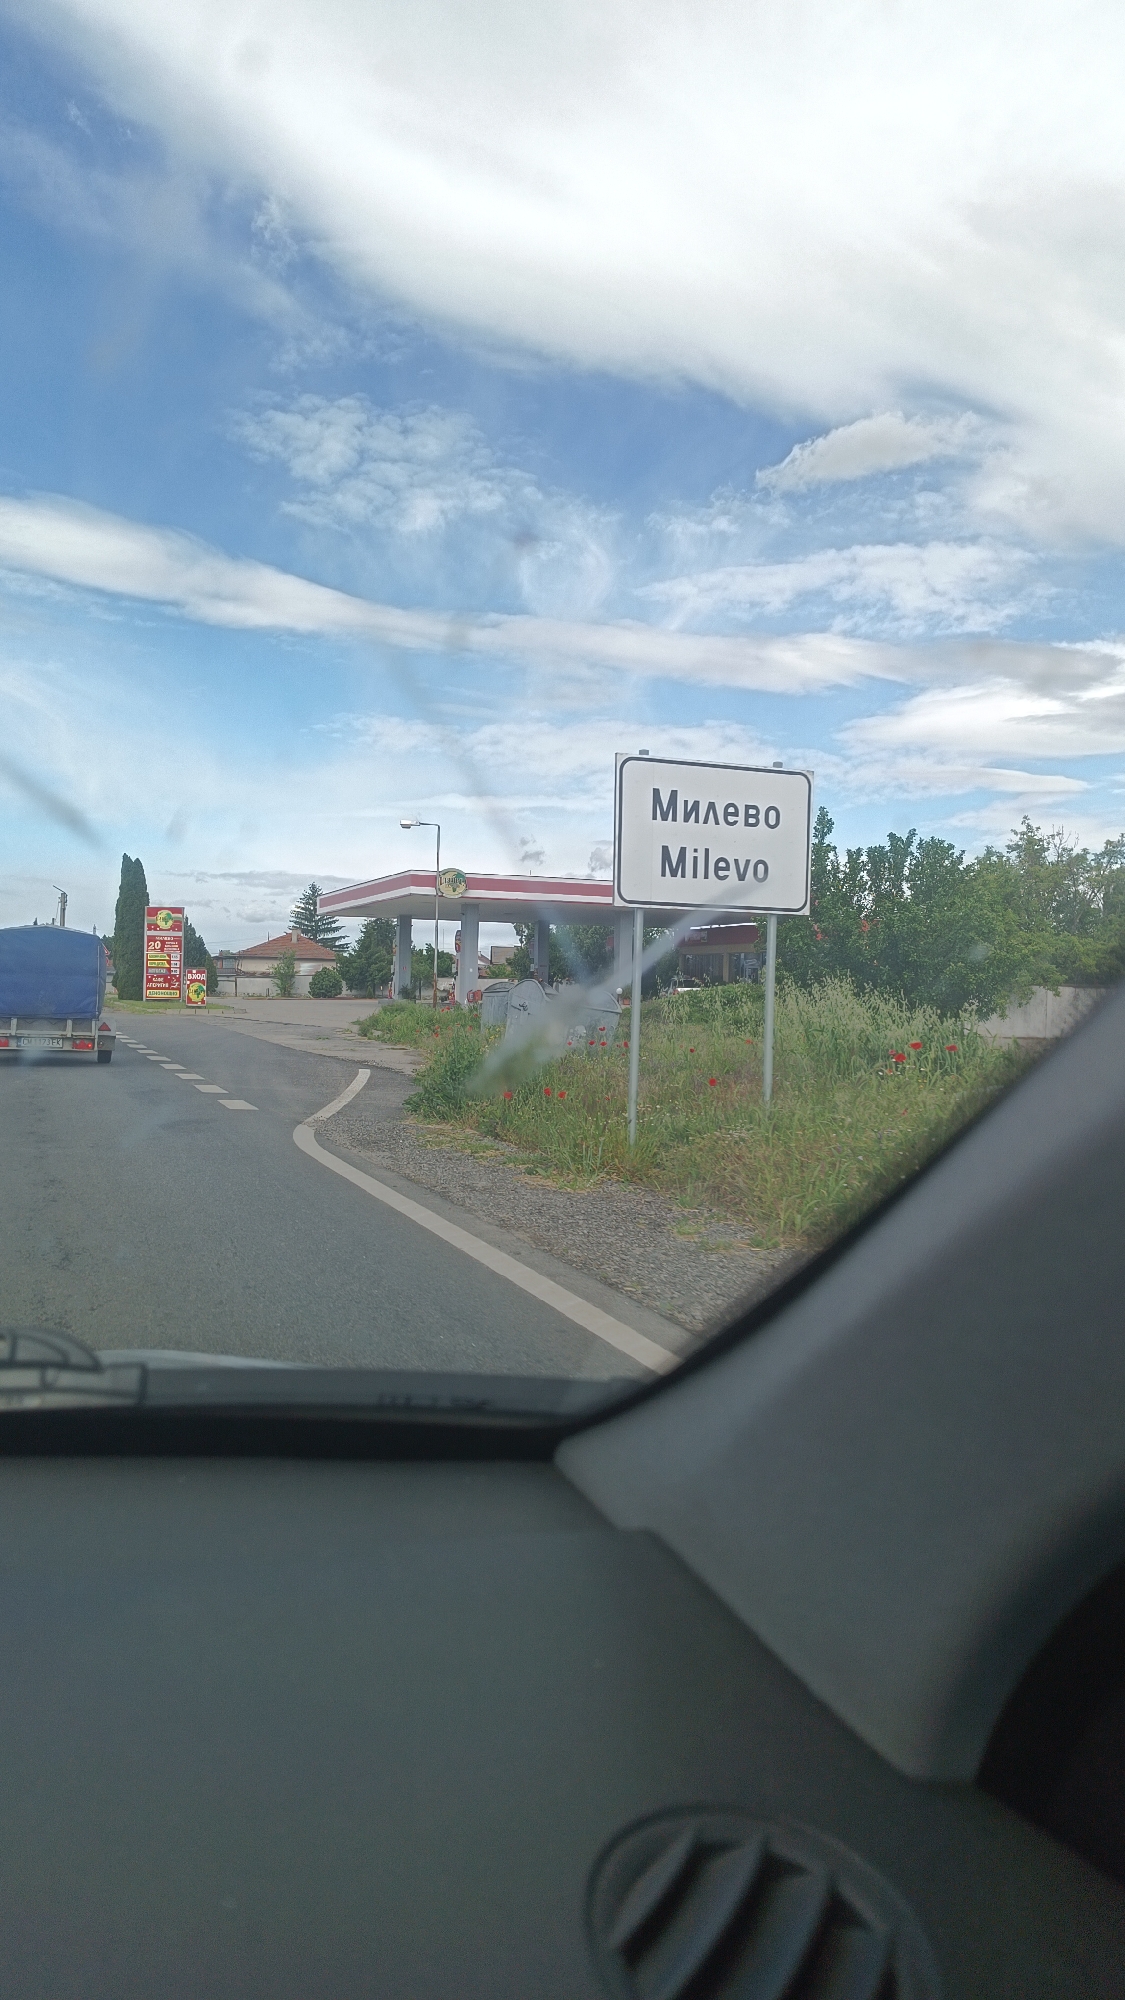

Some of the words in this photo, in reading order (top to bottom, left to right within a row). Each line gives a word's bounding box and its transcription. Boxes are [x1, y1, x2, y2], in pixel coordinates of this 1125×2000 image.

[651, 787, 781, 830] Милево
[660, 844, 770, 884] Milevo
[148, 941, 161, 950] 20
[188, 973, 206, 981] ВХОД
